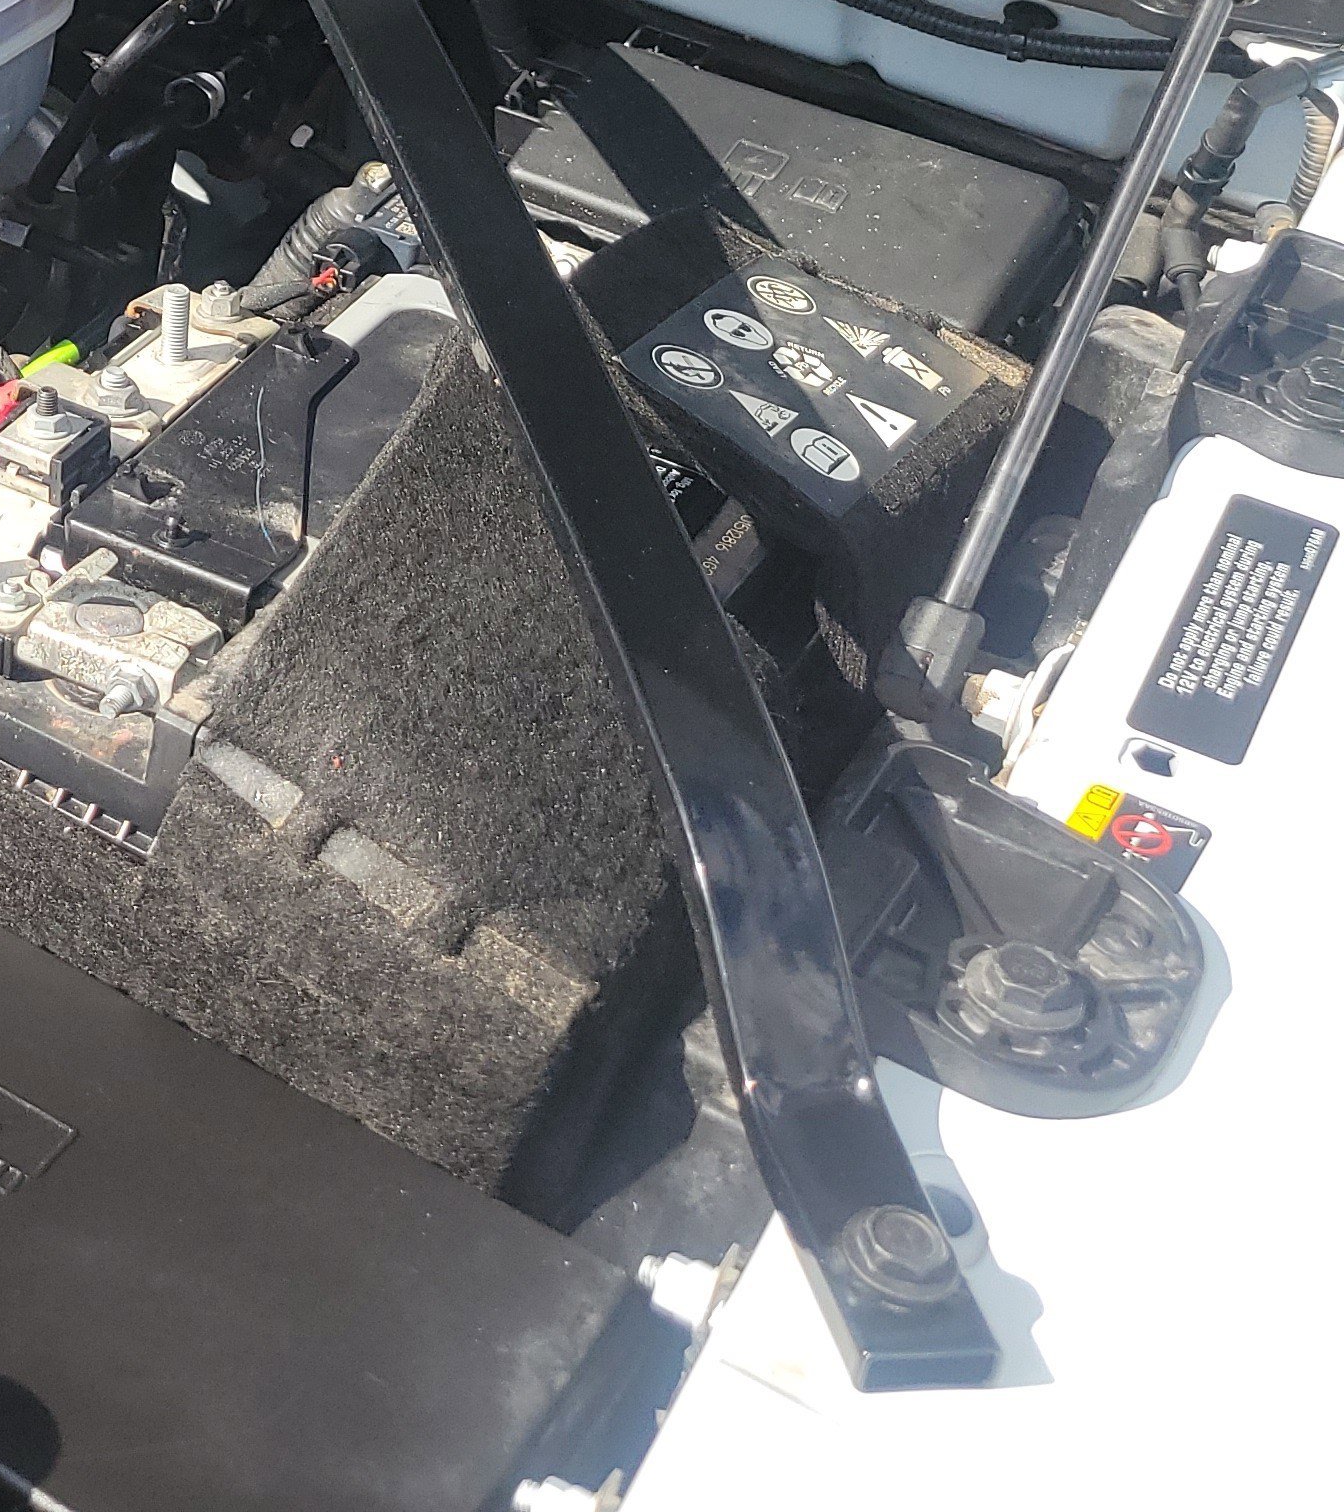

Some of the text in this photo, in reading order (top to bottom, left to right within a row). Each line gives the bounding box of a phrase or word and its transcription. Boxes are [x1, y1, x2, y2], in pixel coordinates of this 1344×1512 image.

[786, 341, 825, 360] RETURN
[822, 375, 848, 397] RECYCLE
[1157, 531, 1243, 689] Do not apply more than nominal
[1175, 539, 1264, 696] 12V to electrical system during
[1201, 560, 1274, 690] charging or jump starting.
[1215, 562, 1291, 701] Engine and starting system
[1243, 588, 1301, 686] failure could result.
